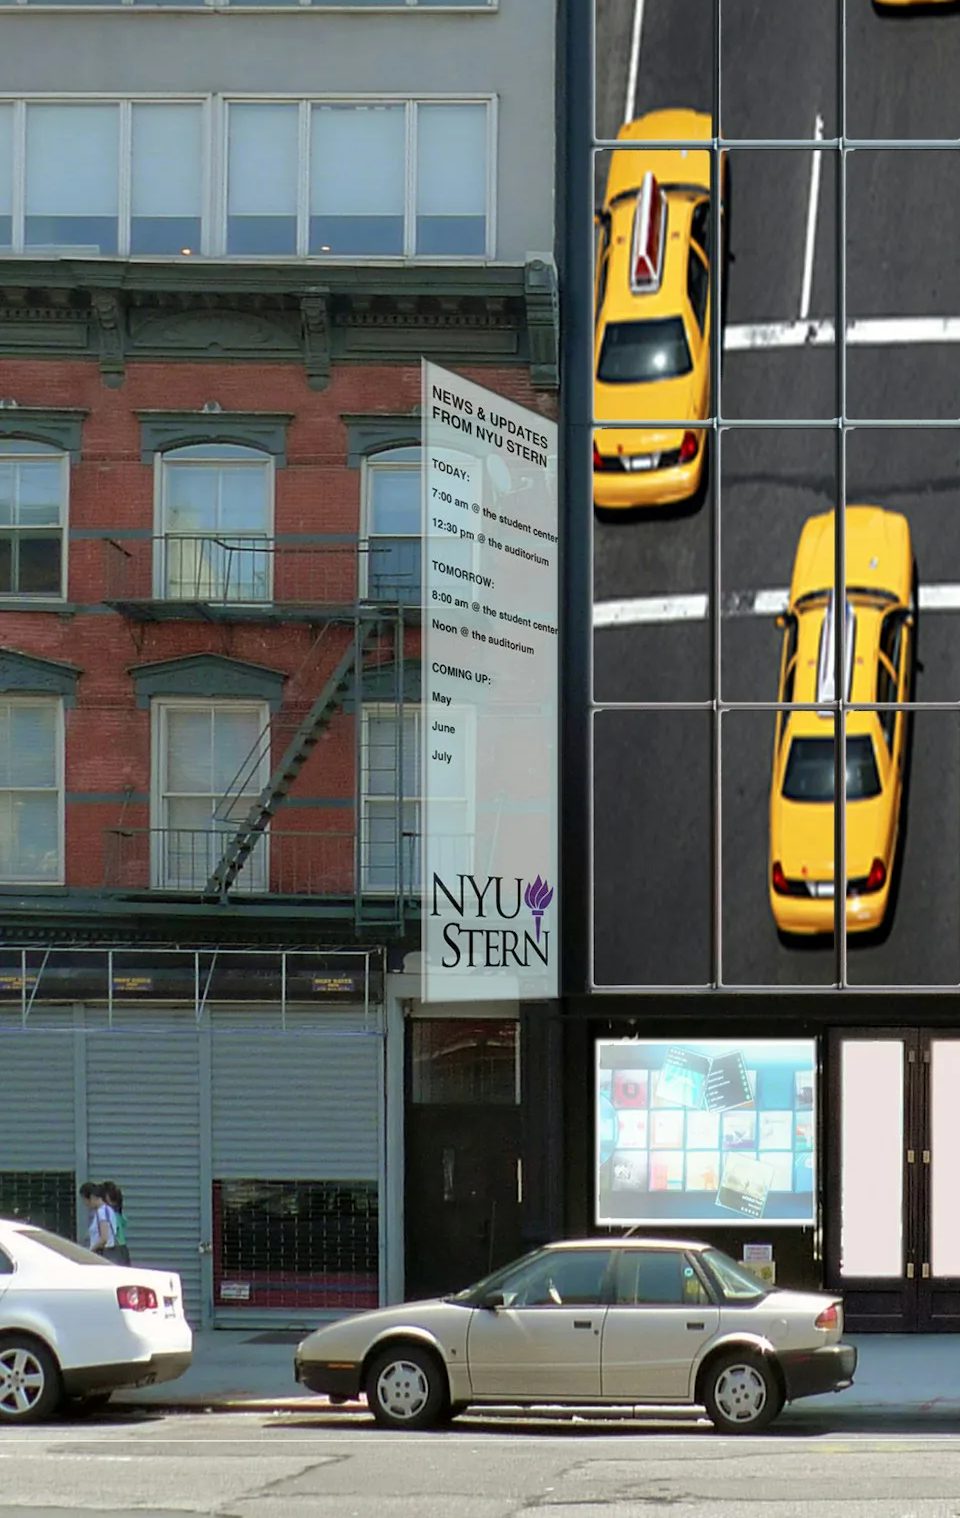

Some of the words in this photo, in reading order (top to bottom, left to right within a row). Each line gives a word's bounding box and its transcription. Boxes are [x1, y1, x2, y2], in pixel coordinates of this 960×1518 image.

[433, 386, 473, 414] NEWS
[477, 407, 486, 422] &
[490, 412, 548, 449] UPDATES
[433, 406, 472, 434] FROM
[476, 426, 502, 448] NYU
[507, 440, 546, 468] STERN
[432, 458, 470, 482] TODAY:
[432, 488, 452, 503] 7:00
[454, 499, 468, 510] am
[472, 503, 480, 514] @
[483, 508, 496, 520] the
[499, 516, 531, 533] student
[533, 529, 558, 542] center
[433, 518, 457, 534] 12:30
[460, 529, 474, 540] pm
[478, 534, 485, 544] @
[488, 538, 502, 550] the
[505, 545, 549, 566] auditorium
[432, 560, 494, 588] TOMORROW:
[432, 590, 452, 604] 8:00
[455, 599, 468, 608] am
[472, 602, 480, 612] @
[483, 606, 496, 617] the
[499, 612, 531, 627] student
[533, 622, 558, 634] center
[432, 619, 457, 634] Noon
[460, 627, 469, 637] @
[472, 630, 486, 642] the
[488, 636, 534, 654] auditorium
[432, 662, 472, 680] COMING
[475, 673, 490, 685] UP:
[432, 692, 451, 706] May
[432, 721, 455, 734] June
[432, 750, 452, 764] July
[430, 872, 524, 919] NYU
[441, 922, 551, 968] STERN
